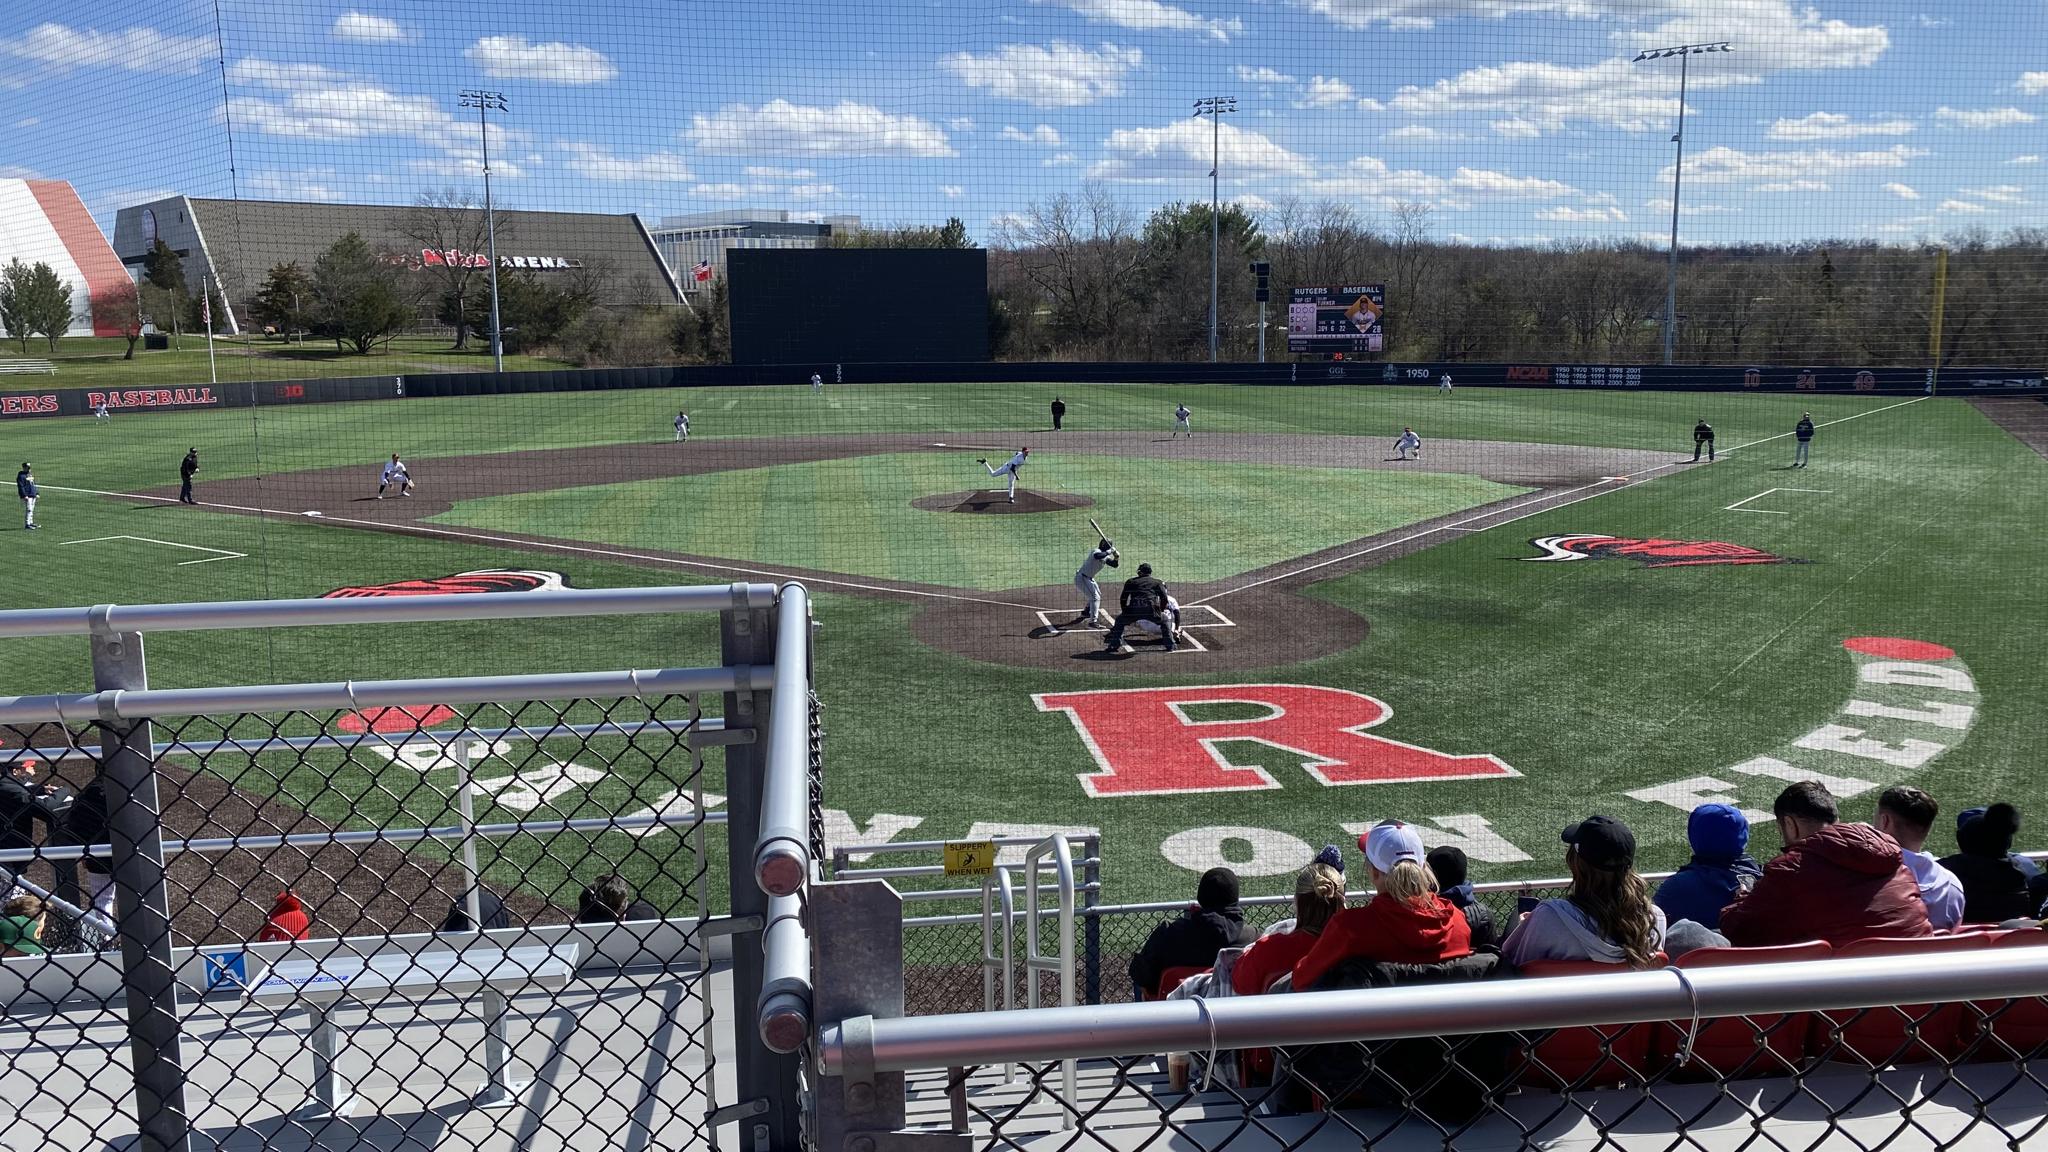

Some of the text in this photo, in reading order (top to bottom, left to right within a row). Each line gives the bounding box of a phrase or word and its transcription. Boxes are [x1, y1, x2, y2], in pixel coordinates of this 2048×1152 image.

[500, 256, 571, 269] ARENA
[1294, 286, 1380, 295] RUTGERS BASEBALL
[1406, 369, 1430, 379] 1950
[1507, 366, 1549, 380] NCAA
[1744, 373, 1760, 387] 10
[1796, 374, 1816, 389] 24
[0, 388, 217, 415] ERS BASEBALL
[1030, 683, 1524, 798] R
[1624, 660, 1977, 823] FIELD
[949, 842, 987, 851] SLIPPERY
[947, 867, 990, 876] WHEN WET
